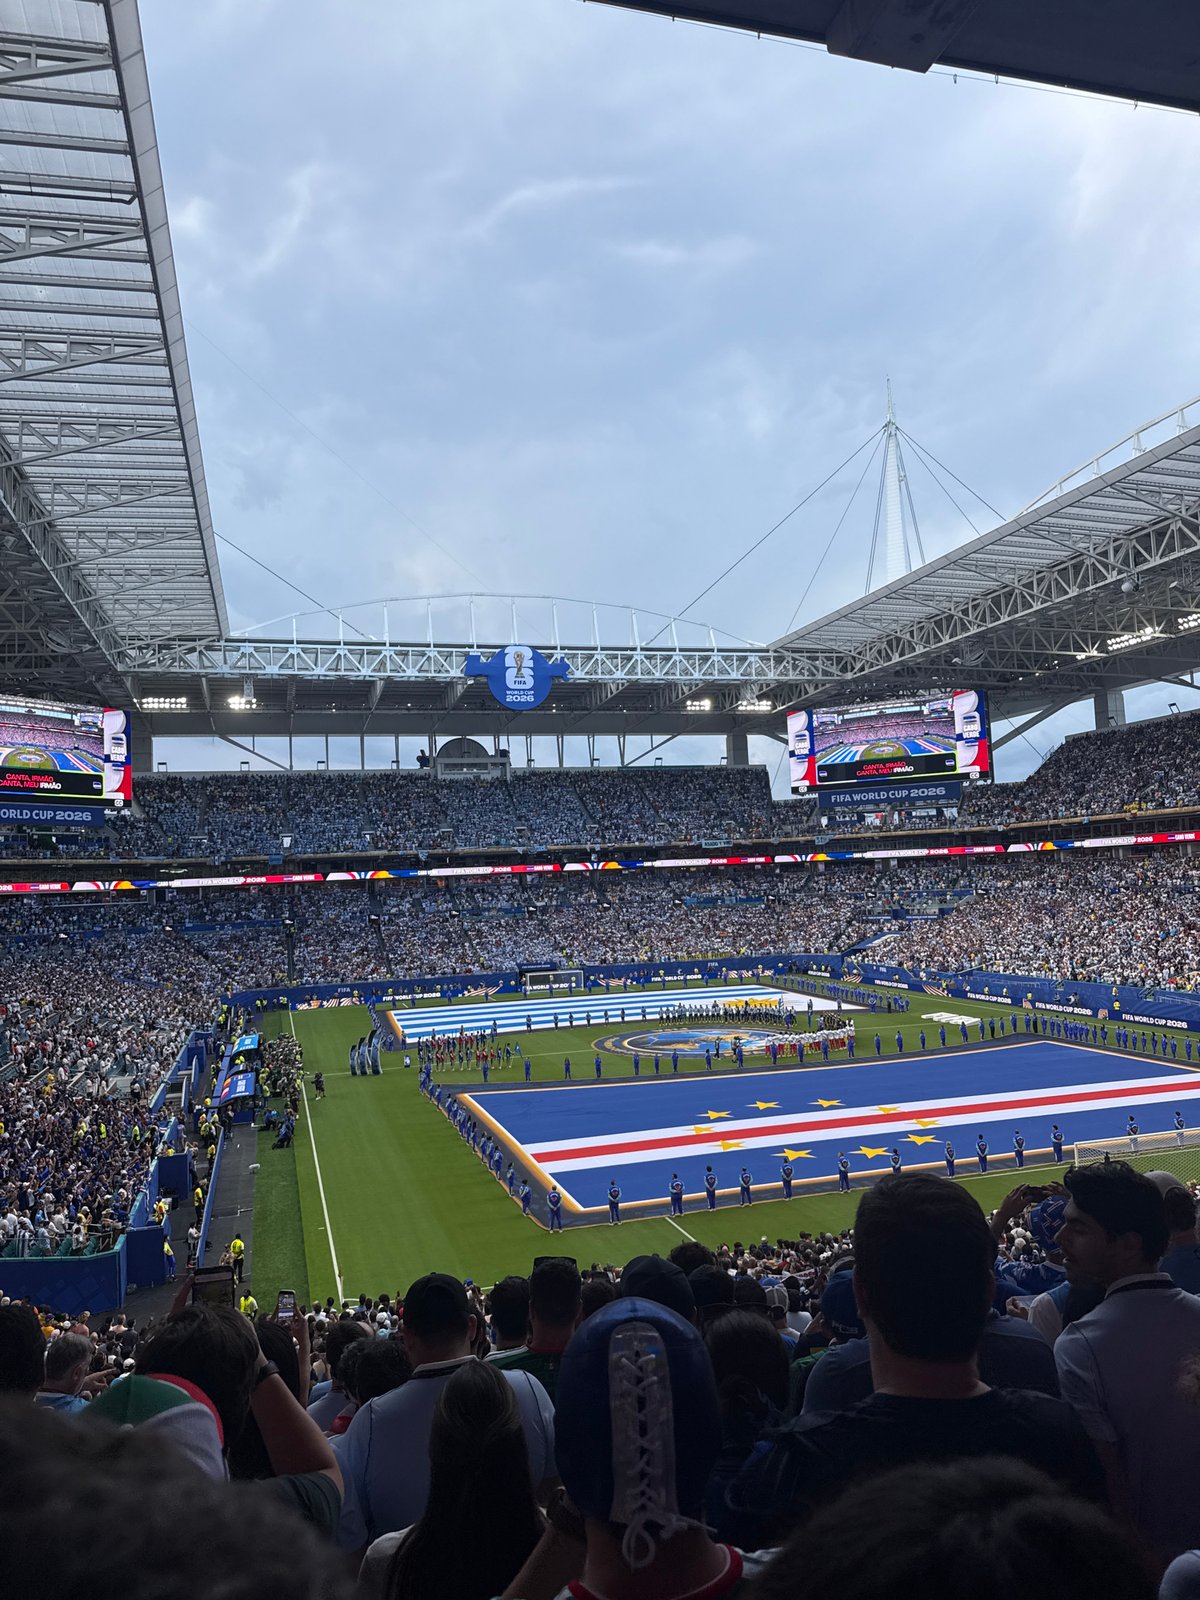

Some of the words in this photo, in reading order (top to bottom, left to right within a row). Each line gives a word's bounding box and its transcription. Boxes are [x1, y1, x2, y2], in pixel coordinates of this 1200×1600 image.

[831, 794, 852, 802] FIFA
[852, 791, 887, 801] WORLD
[889, 790, 908, 798] CUP
[910, 787, 946, 796] 2026
[0, 808, 30, 819] ORLD
[32, 810, 54, 820] CUP
[56, 812, 92, 820] 2026
[1134, 1016, 1154, 1024] WORLD
[1167, 1020, 1187, 1028] 2026
